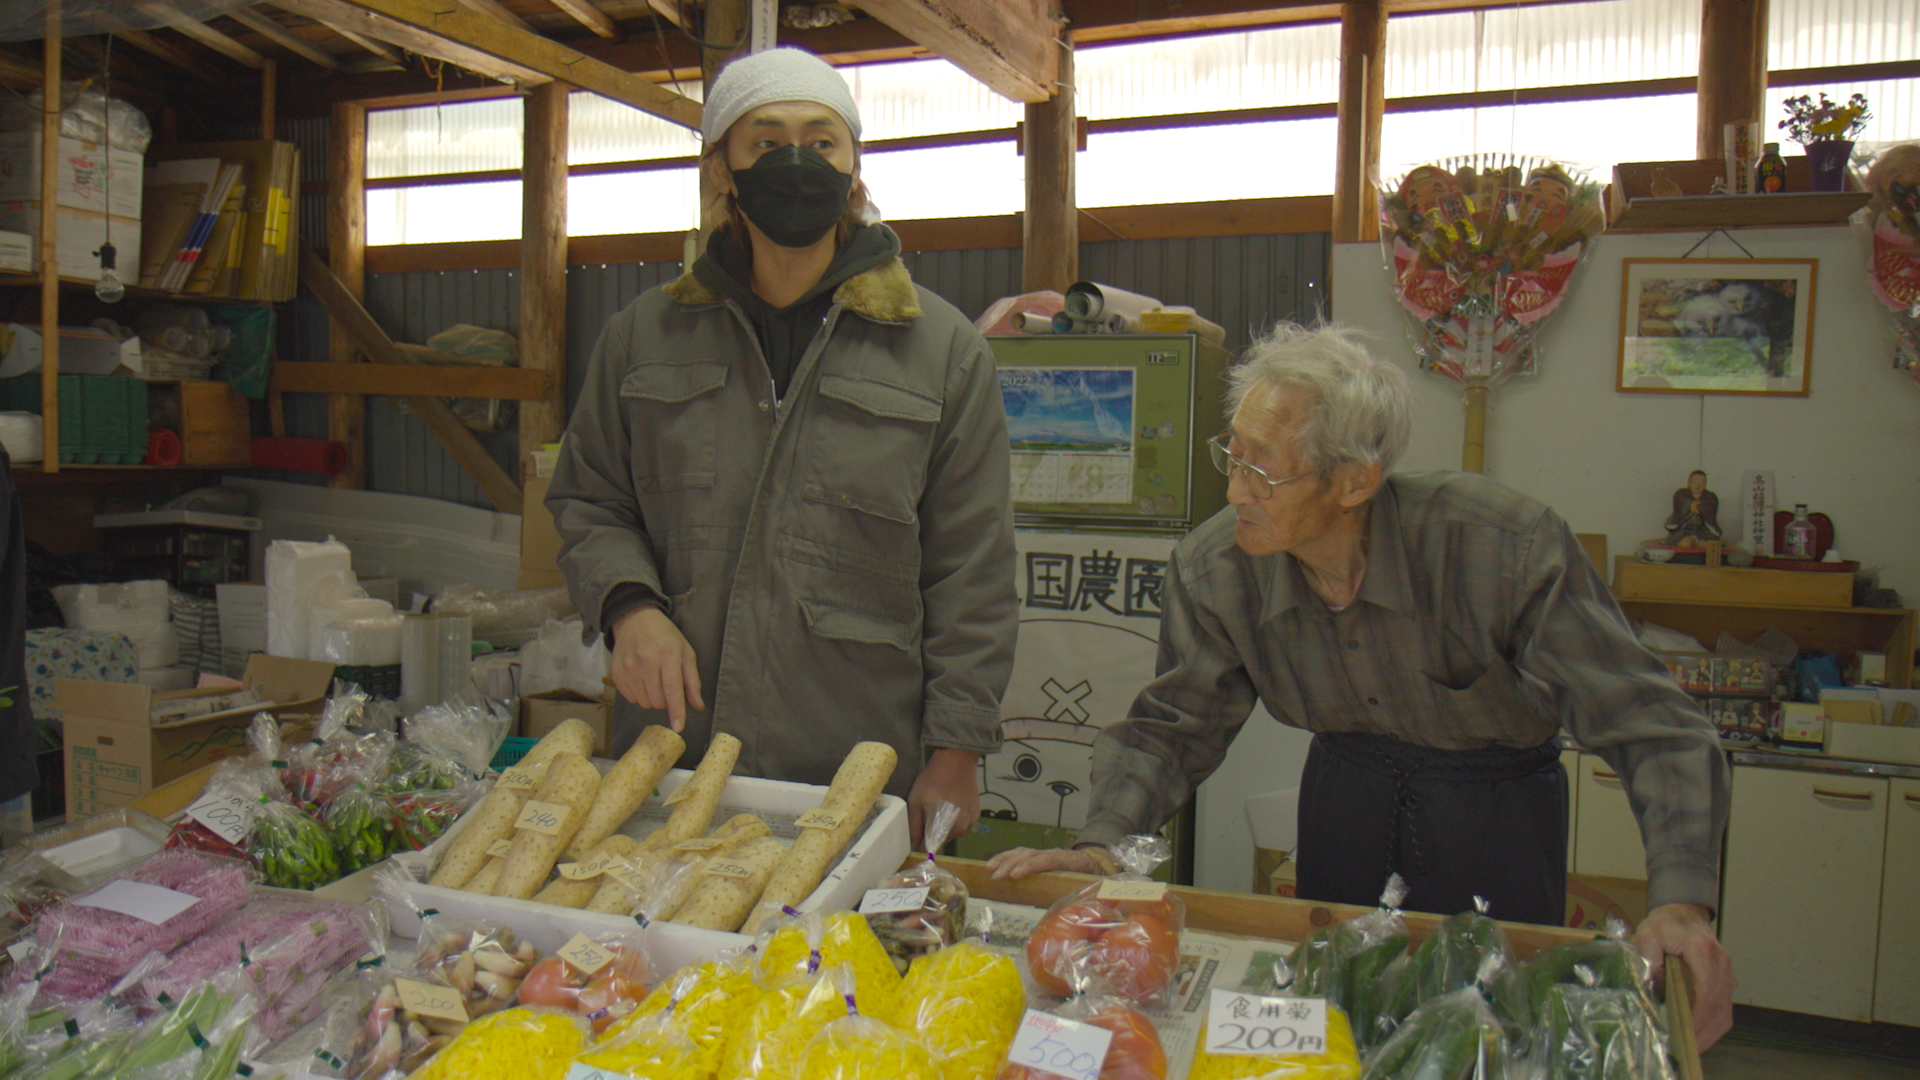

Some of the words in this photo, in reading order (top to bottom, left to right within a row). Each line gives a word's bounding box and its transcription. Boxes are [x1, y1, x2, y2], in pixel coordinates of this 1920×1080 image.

[1000, 376, 1031, 386] 2022
[1085, 463, 1103, 494] 8
[1018, 549, 1170, 619] 国農園
[523, 808, 558, 828] 240
[569, 943, 604, 966] 250
[409, 990, 455, 1010] 200
[1225, 995, 1312, 1021] 食用菊
[1212, 1022, 1323, 1051] 200円
